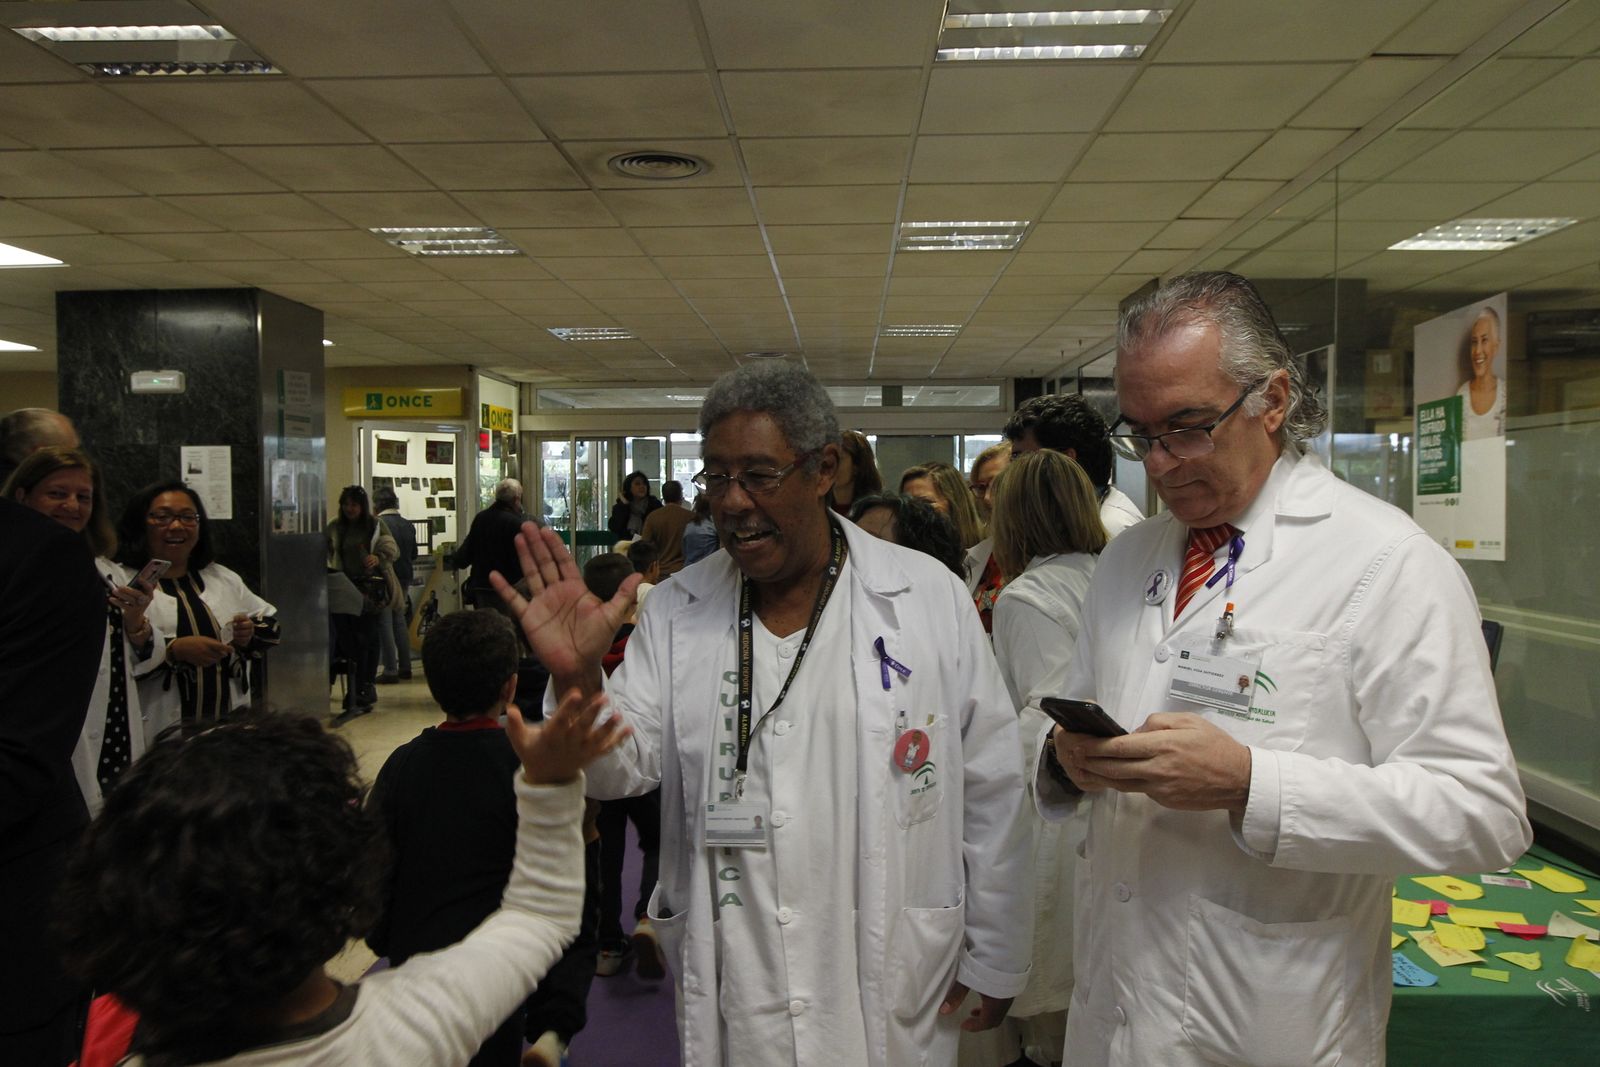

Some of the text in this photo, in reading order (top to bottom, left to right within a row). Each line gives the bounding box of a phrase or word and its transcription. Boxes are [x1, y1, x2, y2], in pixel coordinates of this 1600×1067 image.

[386, 394, 433, 408] ONCE
[490, 410, 513, 430] ONCE
[1420, 408, 1434, 422] ELLA
